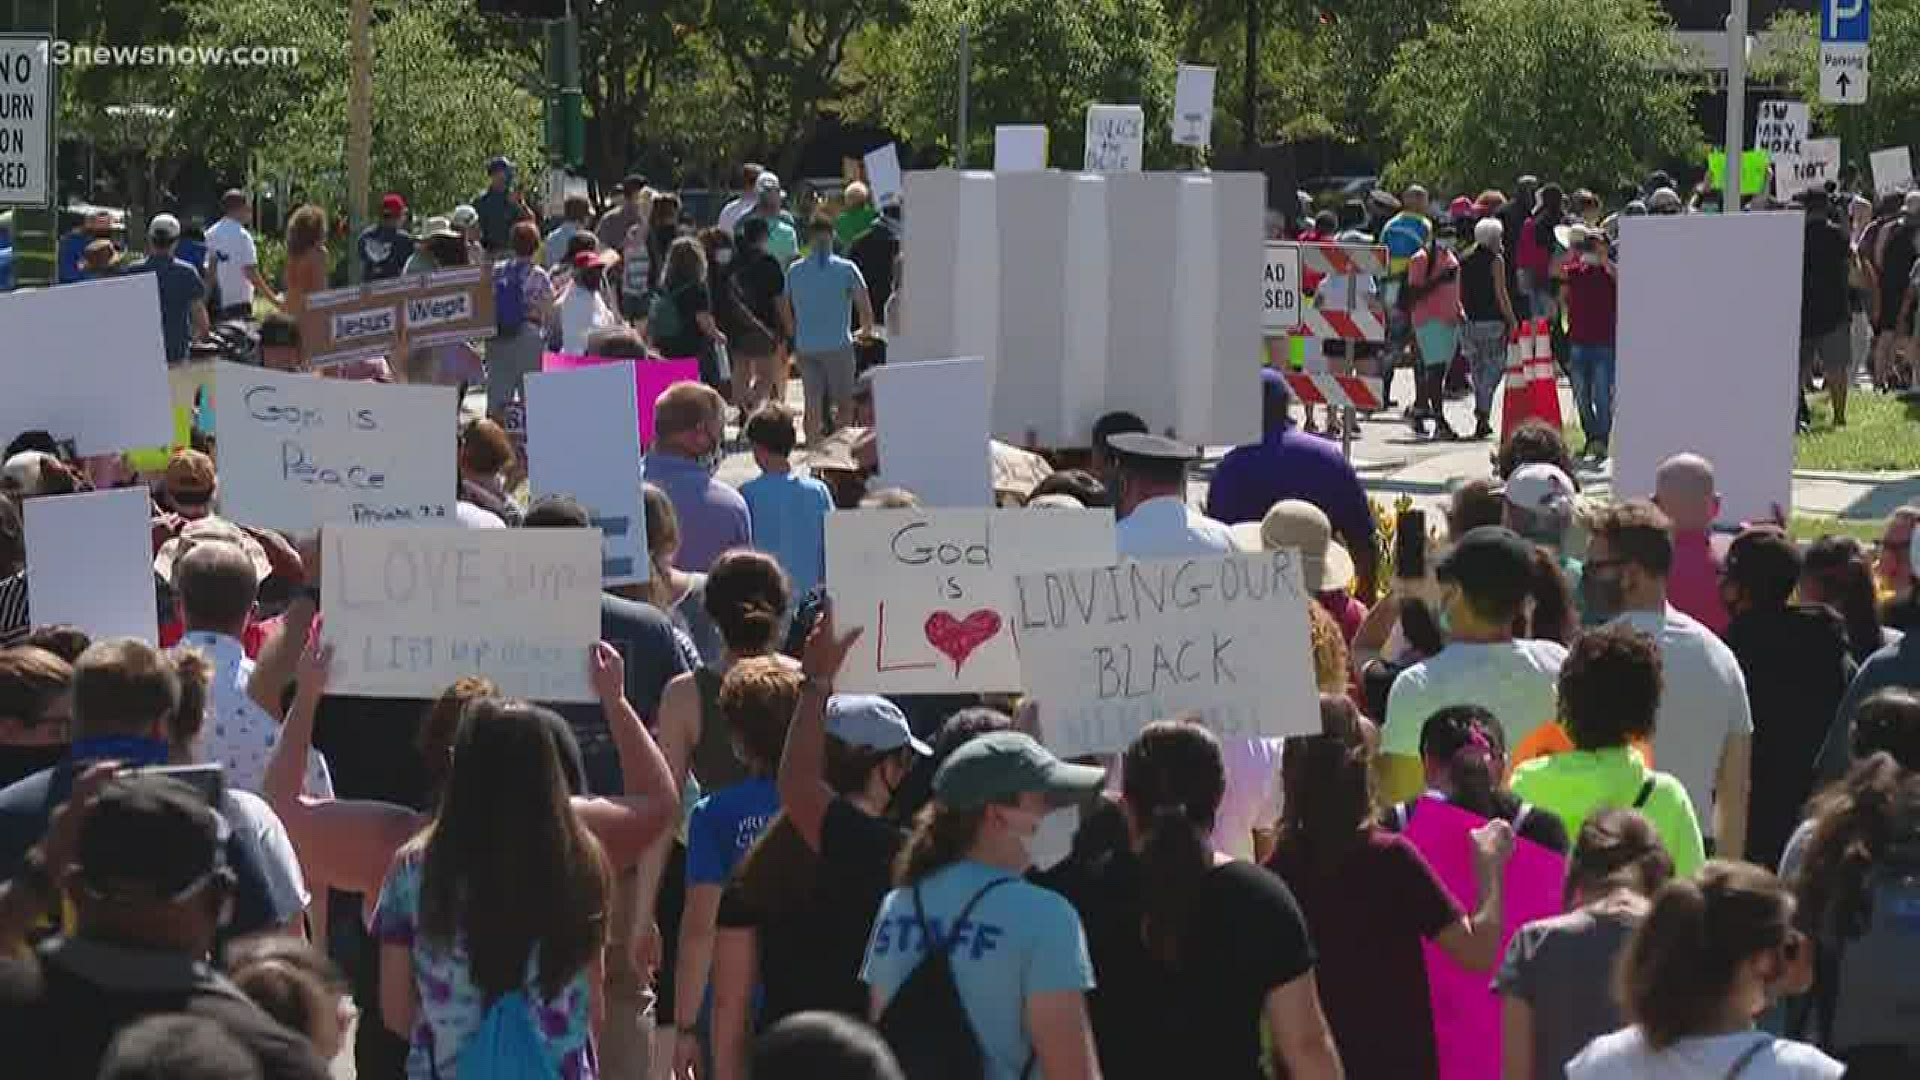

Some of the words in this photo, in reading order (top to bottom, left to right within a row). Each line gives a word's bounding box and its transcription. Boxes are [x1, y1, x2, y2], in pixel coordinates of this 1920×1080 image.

[1830, 0, 1862, 38] P
[1824, 53, 1863, 70] Parking
[0, 93, 33, 120] URN
[1264, 262, 1285, 282] AD
[408, 296, 466, 326] Wept
[1264, 288, 1294, 310] SED
[891, 514, 993, 570] God
[335, 536, 482, 613] LOVE
[936, 575, 963, 599] is
[1092, 632, 1237, 699] BLACK
[873, 914, 1004, 960] STAFF
